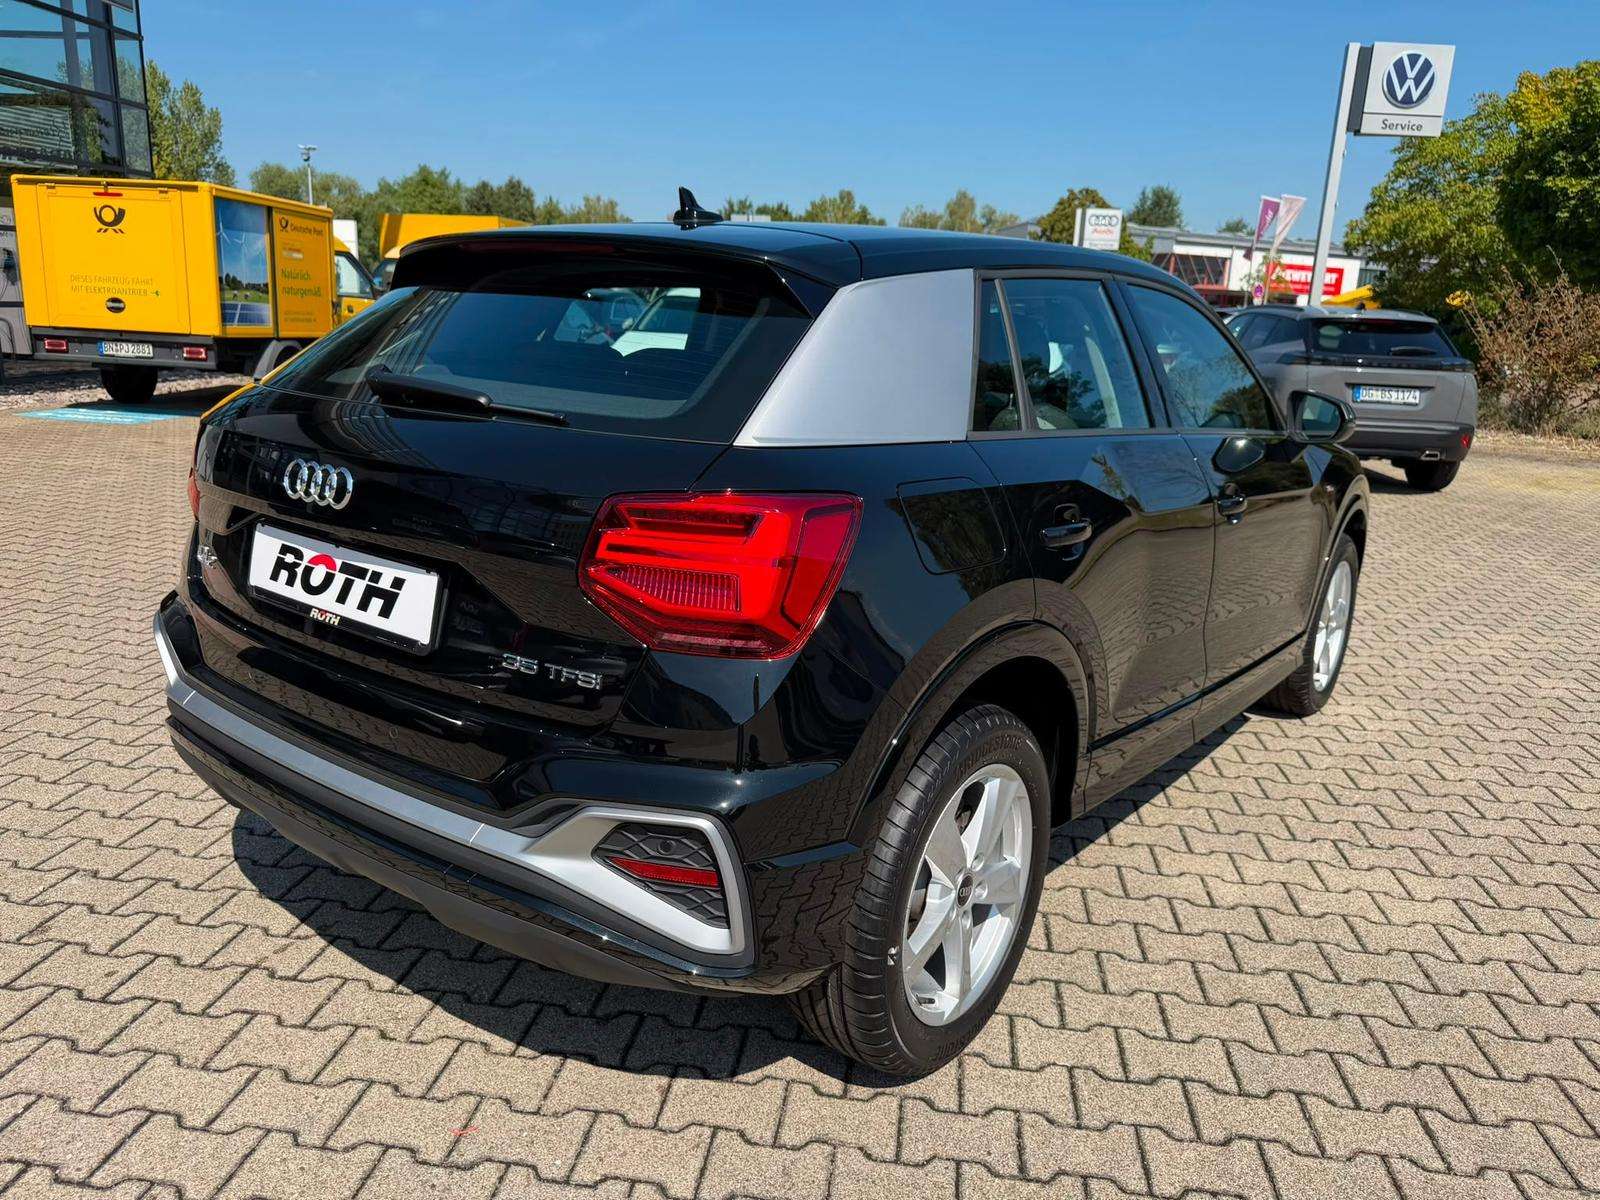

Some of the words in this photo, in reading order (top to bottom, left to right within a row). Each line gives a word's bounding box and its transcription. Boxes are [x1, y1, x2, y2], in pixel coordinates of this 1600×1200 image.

[1381, 118, 1423, 132] Service
[70, 274, 92, 283] DIESES
[94, 275, 130, 285] FAHRZEUG
[71, 285, 83, 293] MIT
[269, 543, 406, 619] ROTH
[310, 607, 341, 626] ROTH
[502, 653, 538, 675] 35
[544, 663, 602, 690] TFSI
